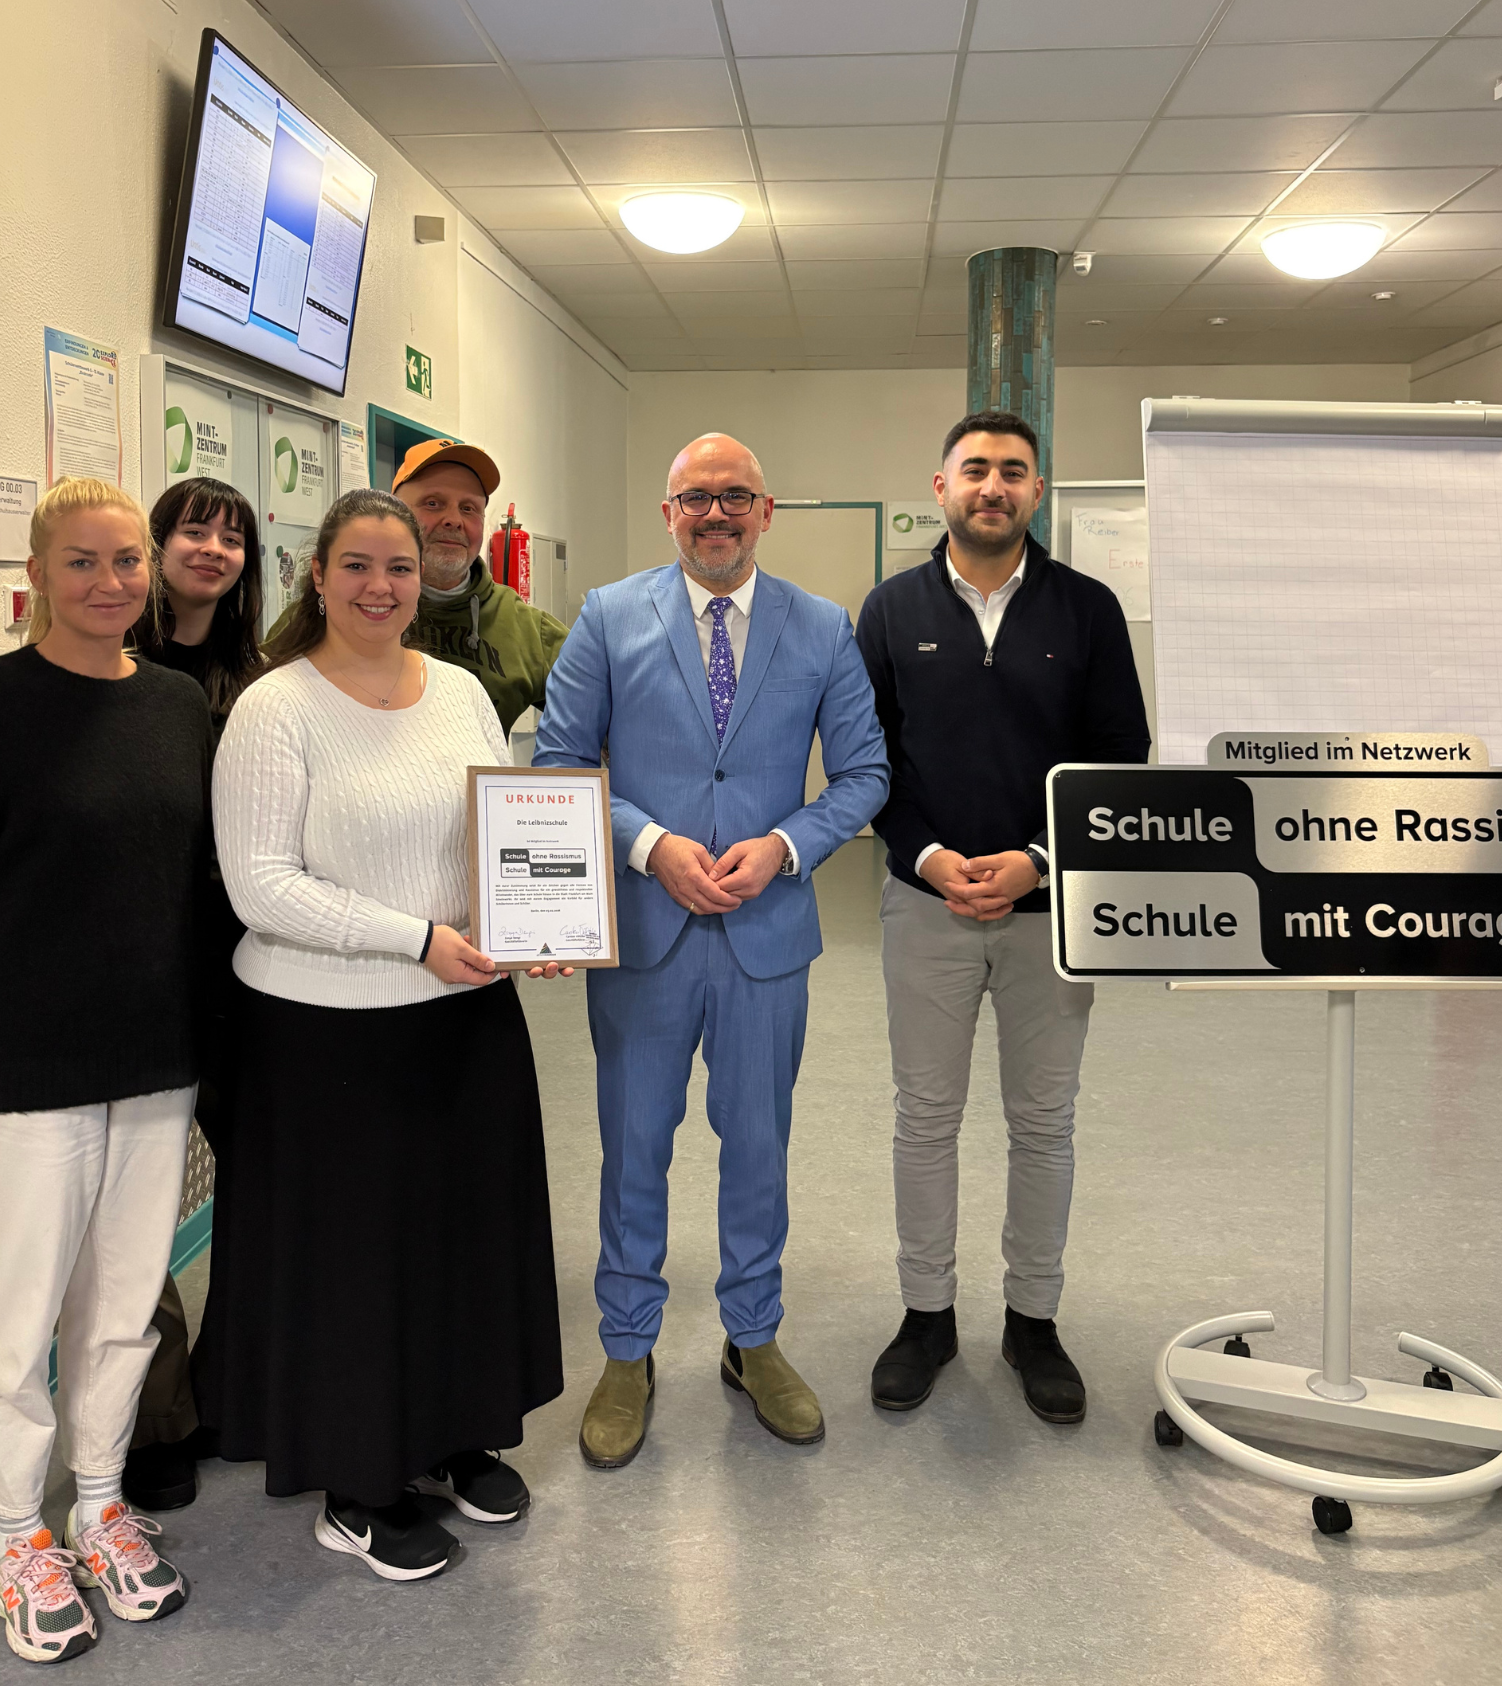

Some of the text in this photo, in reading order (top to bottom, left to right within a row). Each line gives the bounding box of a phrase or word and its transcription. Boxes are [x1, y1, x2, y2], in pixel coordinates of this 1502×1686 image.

[196, 421, 219, 439] MINT-
[196, 436, 227, 457] ZENTRUM
[196, 452, 226, 469] FRANKFURT
[301, 448, 318, 463] MINT-
[196, 466, 211, 478] WEST
[301, 462, 324, 478] ZENTRUM
[1075, 512, 1104, 527] Frau
[1108, 548, 1144, 570] Erste
[1224, 740, 1472, 765] Mitglied im Netzwerk
[505, 793, 575, 804] URKUNDE
[1088, 806, 1502, 842] Schule ohne Rassi
[544, 866, 572, 874] Courage
[1092, 902, 1502, 946] Schule mit Coura
